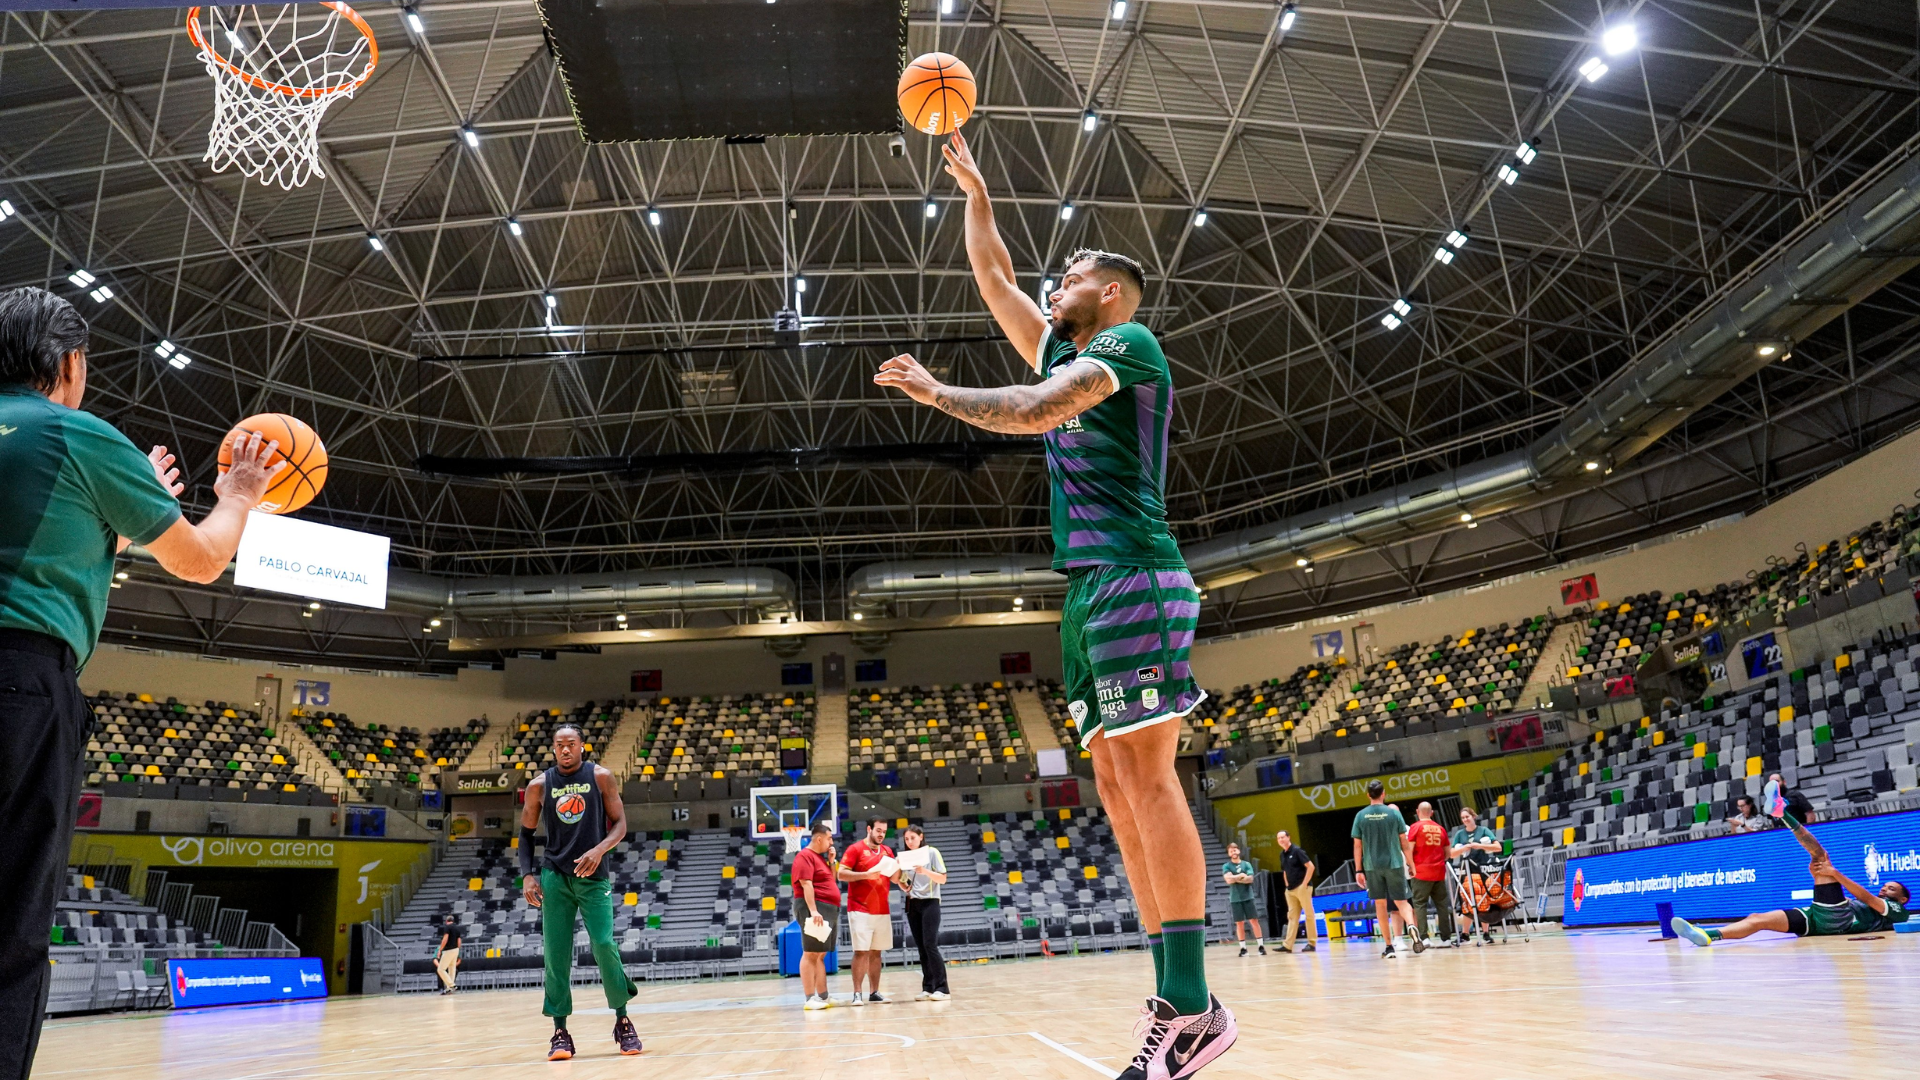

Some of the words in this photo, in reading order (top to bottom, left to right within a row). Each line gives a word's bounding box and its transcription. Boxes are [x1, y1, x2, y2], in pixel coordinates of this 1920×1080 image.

[259, 556, 301, 572] PABLO
[307, 565, 368, 584] CARVAJAL
[1561, 574, 1599, 605] 20
[1315, 630, 1343, 657] 19
[1674, 644, 1699, 662] Salida
[1764, 645, 1783, 665] 22
[1141, 672, 1155, 680] acb
[1711, 664, 1727, 682] 22
[299, 681, 330, 706] 13
[1098, 680, 1126, 702] má
[1100, 700, 1128, 719] aga
[1497, 715, 1544, 751] 20
[458, 779, 492, 789] Salida
[498, 773, 508, 787] 6
[1337, 779, 1382, 798] oliv
[1388, 769, 1450, 790] arena
[352, 808, 386, 836] 13
[673, 809, 690, 821] 15
[733, 806, 748, 818] 15
[209, 837, 262, 856] olivo
[270, 842, 334, 857] arena
[1425, 833, 1442, 847] 35
[1878, 852, 1889, 872] Mi
[1585, 879, 1624, 899] Comprometidos
[1624, 881, 1635, 894] con
[1685, 871, 1714, 888] bienestar
[1715, 868, 1724, 885] de
[1725, 867, 1756, 884] nuestros
